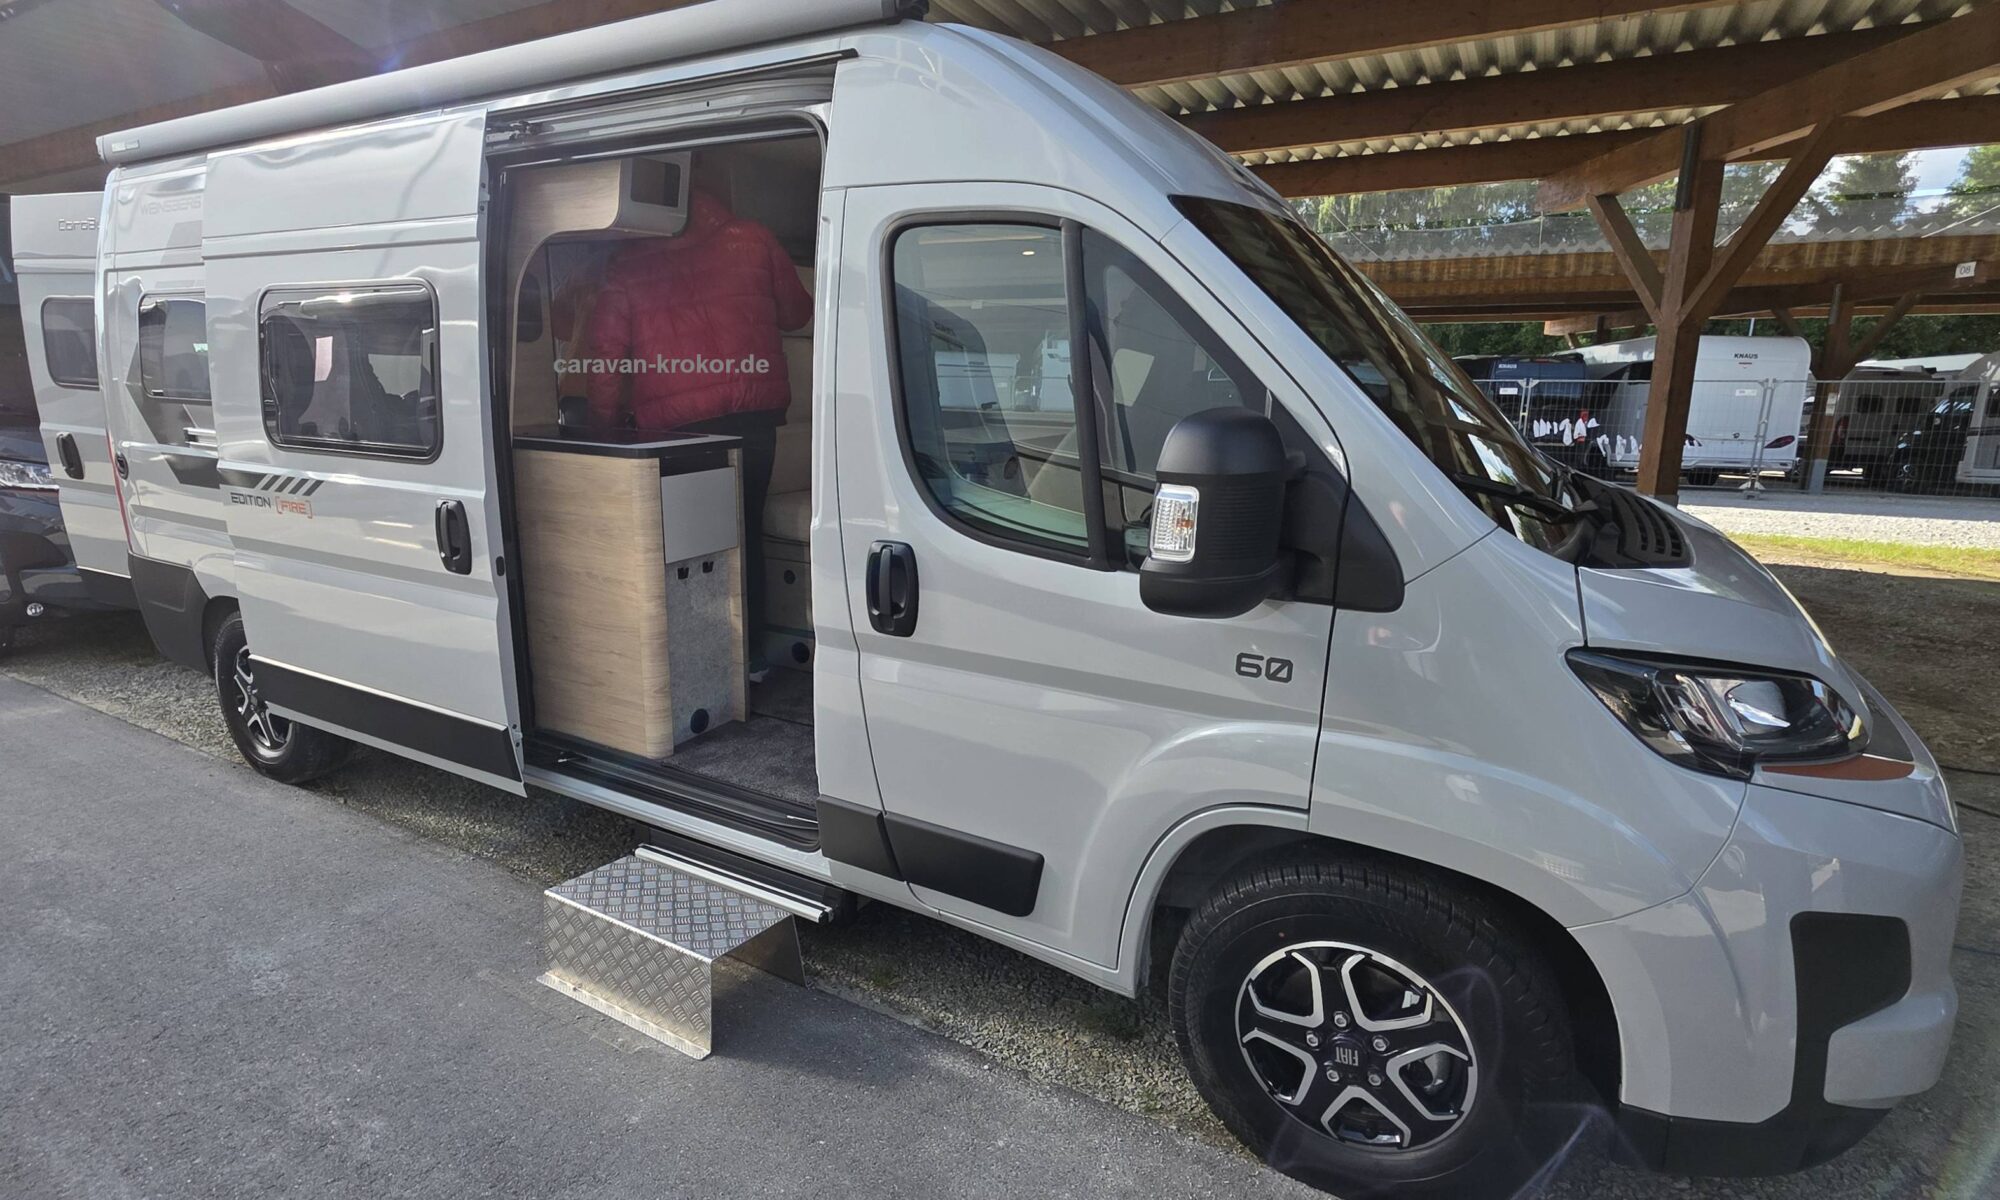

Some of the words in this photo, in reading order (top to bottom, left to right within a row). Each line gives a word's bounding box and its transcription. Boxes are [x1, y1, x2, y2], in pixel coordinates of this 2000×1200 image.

[58, 217, 100, 232] CaraB
[230, 492, 272, 509] EDITION
[1235, 652, 1294, 684] 60
[1334, 1046, 1359, 1067] FIAT
